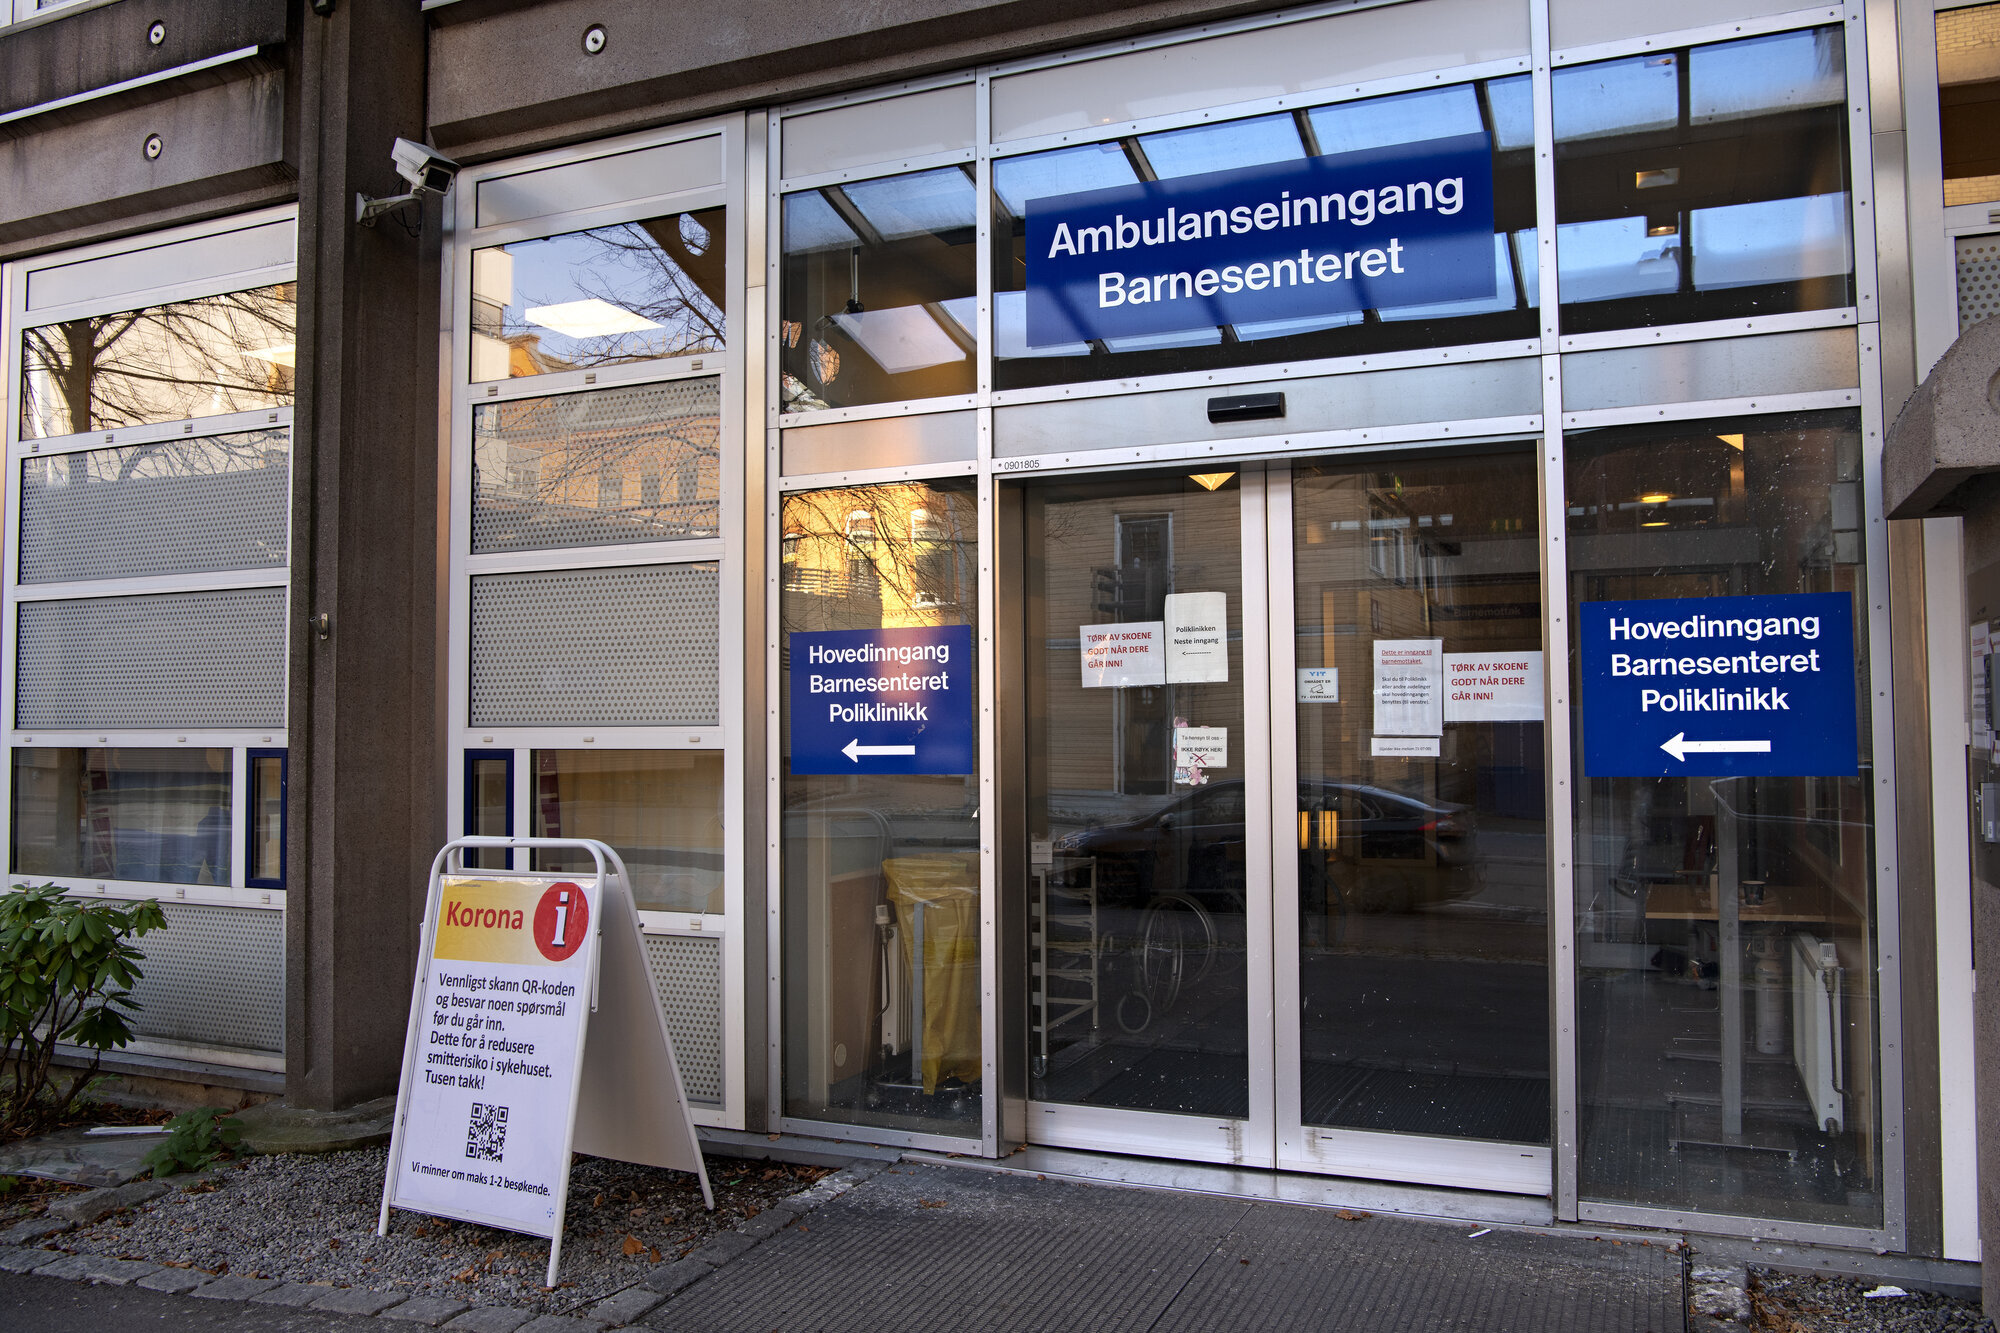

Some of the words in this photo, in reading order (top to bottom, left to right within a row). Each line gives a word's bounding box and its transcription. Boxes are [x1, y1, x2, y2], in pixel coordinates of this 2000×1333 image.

[1047, 177, 1464, 258] Ambulanseinngang
[1099, 238, 1404, 308] Barnesenteret
[1004, 460, 1040, 470] 0901805
[1087, 632, 1108, 642] TØRK
[1109, 633, 1120, 641] AV
[1122, 632, 1152, 640] SKOENE
[1609, 615, 1820, 641] Hovedinngang
[1088, 648, 1108, 656] GODT
[1110, 646, 1128, 654] NÅR
[1130, 646, 1149, 654] DERE
[1194, 637, 1219, 646] inngang
[809, 643, 950, 664] Hovedinngang
[1088, 659, 1104, 668] GÅR
[1105, 660, 1123, 668] INN!
[1611, 649, 1820, 676] Barnesenteret
[1451, 664, 1475, 672] TØRK
[1492, 662, 1528, 670] SKOENE
[810, 672, 949, 693] Barnesenteret
[1452, 678, 1477, 686] GODT
[1480, 676, 1499, 685] NÅR
[1502, 677, 1525, 685] DERE
[1452, 690, 1470, 700] GÅR
[1473, 692, 1494, 700] INN!
[1641, 687, 1790, 712] Poliklinikk
[830, 702, 928, 722] Poliklinikk
[446, 901, 524, 930] Korona
[439, 973, 486, 992] Vennligst
[488, 977, 519, 992] skann
[522, 979, 575, 996] QR-koden
[436, 994, 449, 1009] og
[451, 993, 486, 1009] besvar
[488, 999, 514, 1012] noen
[516, 1001, 566, 1016] spørsmål
[433, 1011, 449, 1026] før
[451, 1013, 464, 1027] du
[466, 1014, 484, 1031] går
[486, 1016, 505, 1031] inn.
[430, 1031, 459, 1046] Dette
[462, 1033, 477, 1048] for
[479, 1035, 485, 1049] å
[488, 1038, 535, 1055] redusere
[427, 1052, 488, 1070] smitterisiko
[491, 1057, 494, 1070] i
[496, 1057, 552, 1078] sykehuset.
[425, 1070, 455, 1086] Tusen
[458, 1072, 485, 1090] takk!
[412, 1161, 421, 1172] Vi
[421, 1164, 450, 1177] minner
[451, 1170, 464, 1180] om
[466, 1172, 487, 1185] maks
[489, 1175, 502, 1187] 1-2
[504, 1176, 550, 1197] besøkende.
